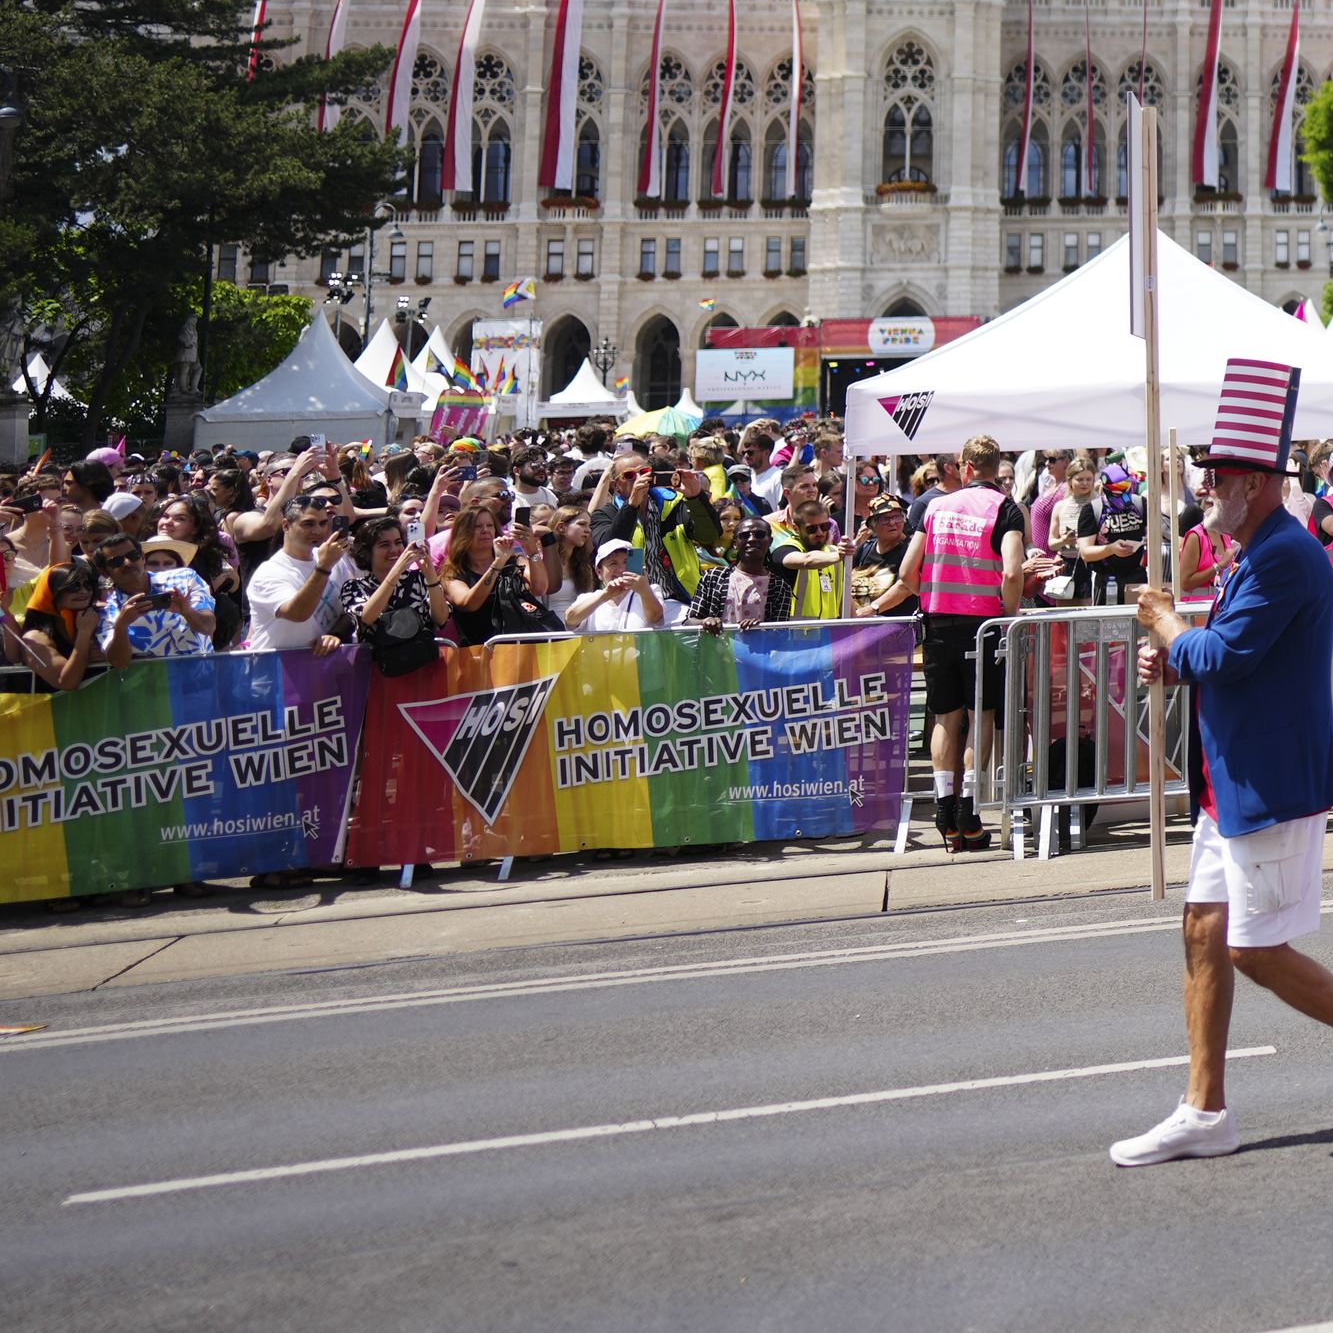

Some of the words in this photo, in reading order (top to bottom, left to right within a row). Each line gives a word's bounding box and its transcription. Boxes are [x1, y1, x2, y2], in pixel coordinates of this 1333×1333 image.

[724, 370, 766, 382] NYX
[897, 394, 934, 412] HOSI
[456, 691, 546, 740] HOSI
[554, 672, 888, 751] HOMOSEXUELLE
[0, 695, 345, 791] OMOSEXUELLE
[556, 728, 773, 789] INITIATIVE
[790, 708, 891, 754] WIEN
[0, 760, 214, 833] ITIATIVE
[229, 733, 348, 789] WIEN
[728, 775, 865, 800] www.hosiwien.at
[160, 805, 320, 843] www.hosiwien.at
